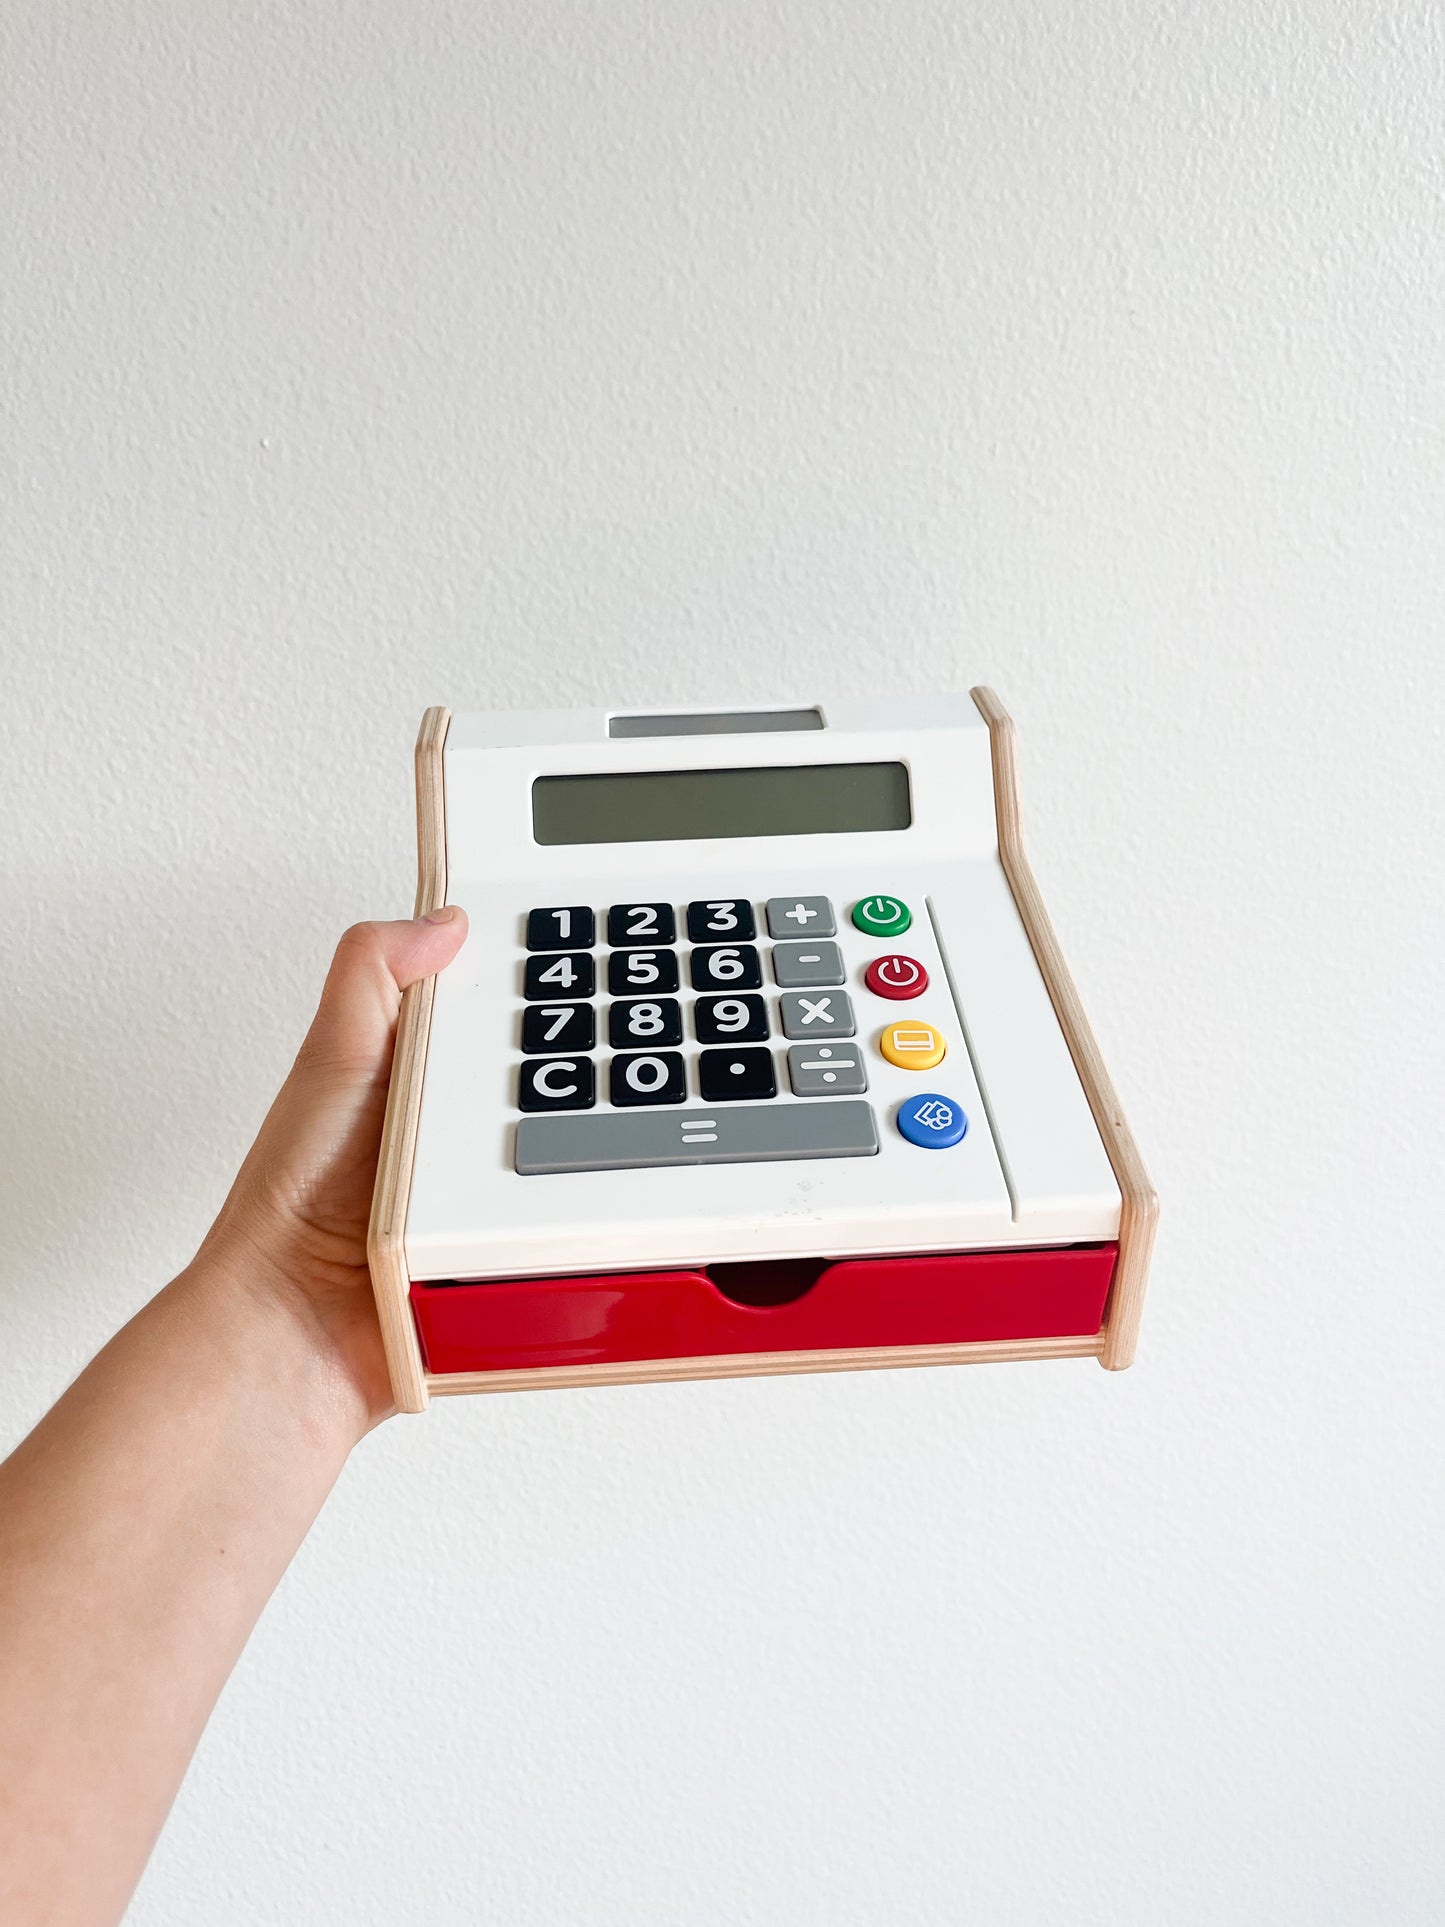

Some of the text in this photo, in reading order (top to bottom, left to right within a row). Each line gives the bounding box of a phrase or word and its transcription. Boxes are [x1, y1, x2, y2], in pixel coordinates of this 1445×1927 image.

[552, 910, 570, 938] 1
[627, 907, 658, 935] 2
[707, 903, 737, 930] 3
[539, 957, 577, 987] 4
[627, 954, 659, 983] 5
[709, 949, 744, 979] 6
[541, 1008, 574, 1040] 7
[629, 1003, 664, 1035] 8
[713, 1000, 749, 1031] 9
[533, 1062, 577, 1097] C
[626, 1057, 668, 1092] 0
